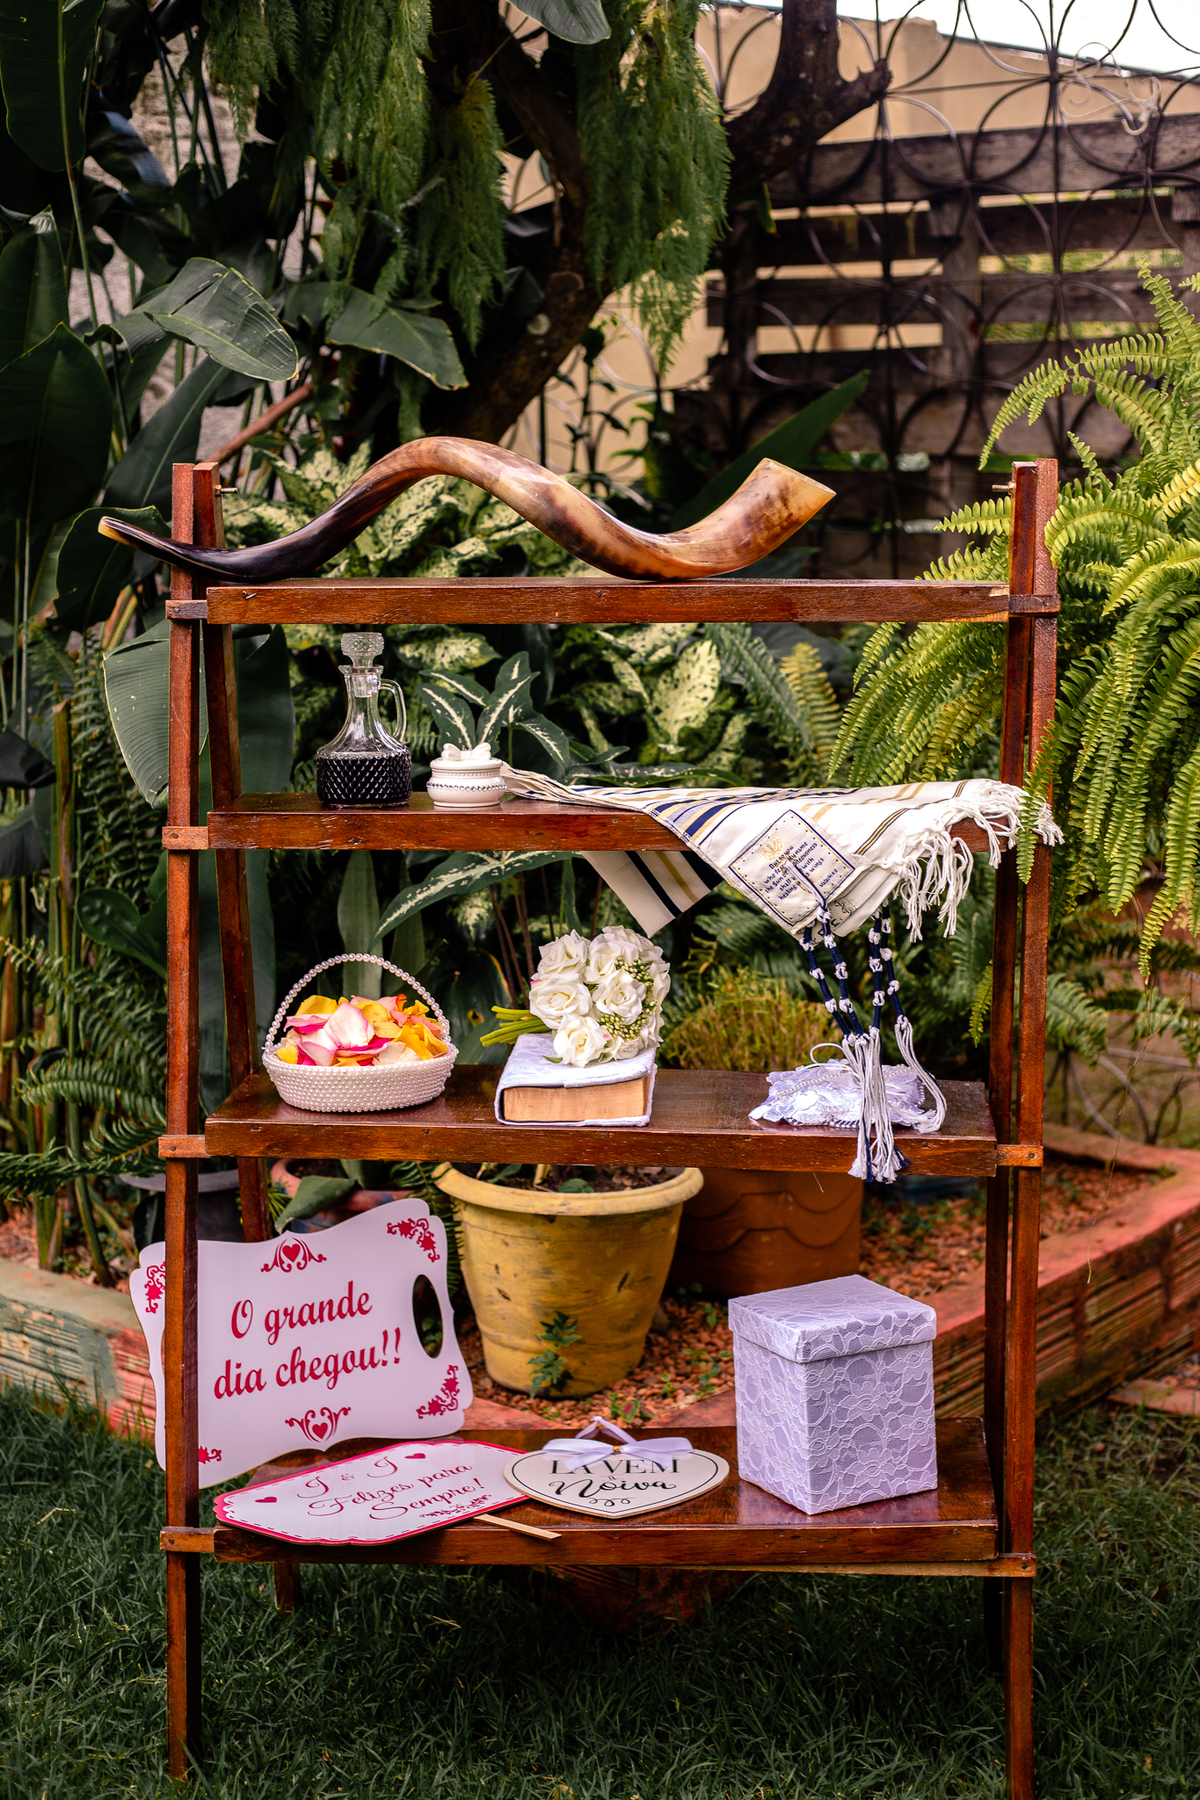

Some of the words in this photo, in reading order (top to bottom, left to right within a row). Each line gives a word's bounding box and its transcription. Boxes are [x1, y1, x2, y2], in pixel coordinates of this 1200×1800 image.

[764, 873, 776, 884] who
[795, 841, 808, 855] name
[769, 859, 781, 869] But
[784, 845, 794, 855] you
[778, 884, 798, 900] healing
[809, 857, 825, 872] wings
[779, 878, 792, 891] shall
[802, 857, 815, 869] with
[772, 876, 784, 887] Sun
[231, 1299, 254, 1339] O
[264, 1280, 373, 1346] grande
[214, 1359, 267, 1400] dia
[276, 1327, 401, 1390] chegou!!
[602, 1458, 681, 1474] VEM
[307, 1482, 414, 1517] Felizes
[417, 1464, 474, 1488] para
[369, 1477, 485, 1521] Sempre!
[548, 1478, 677, 1498] Noiva
